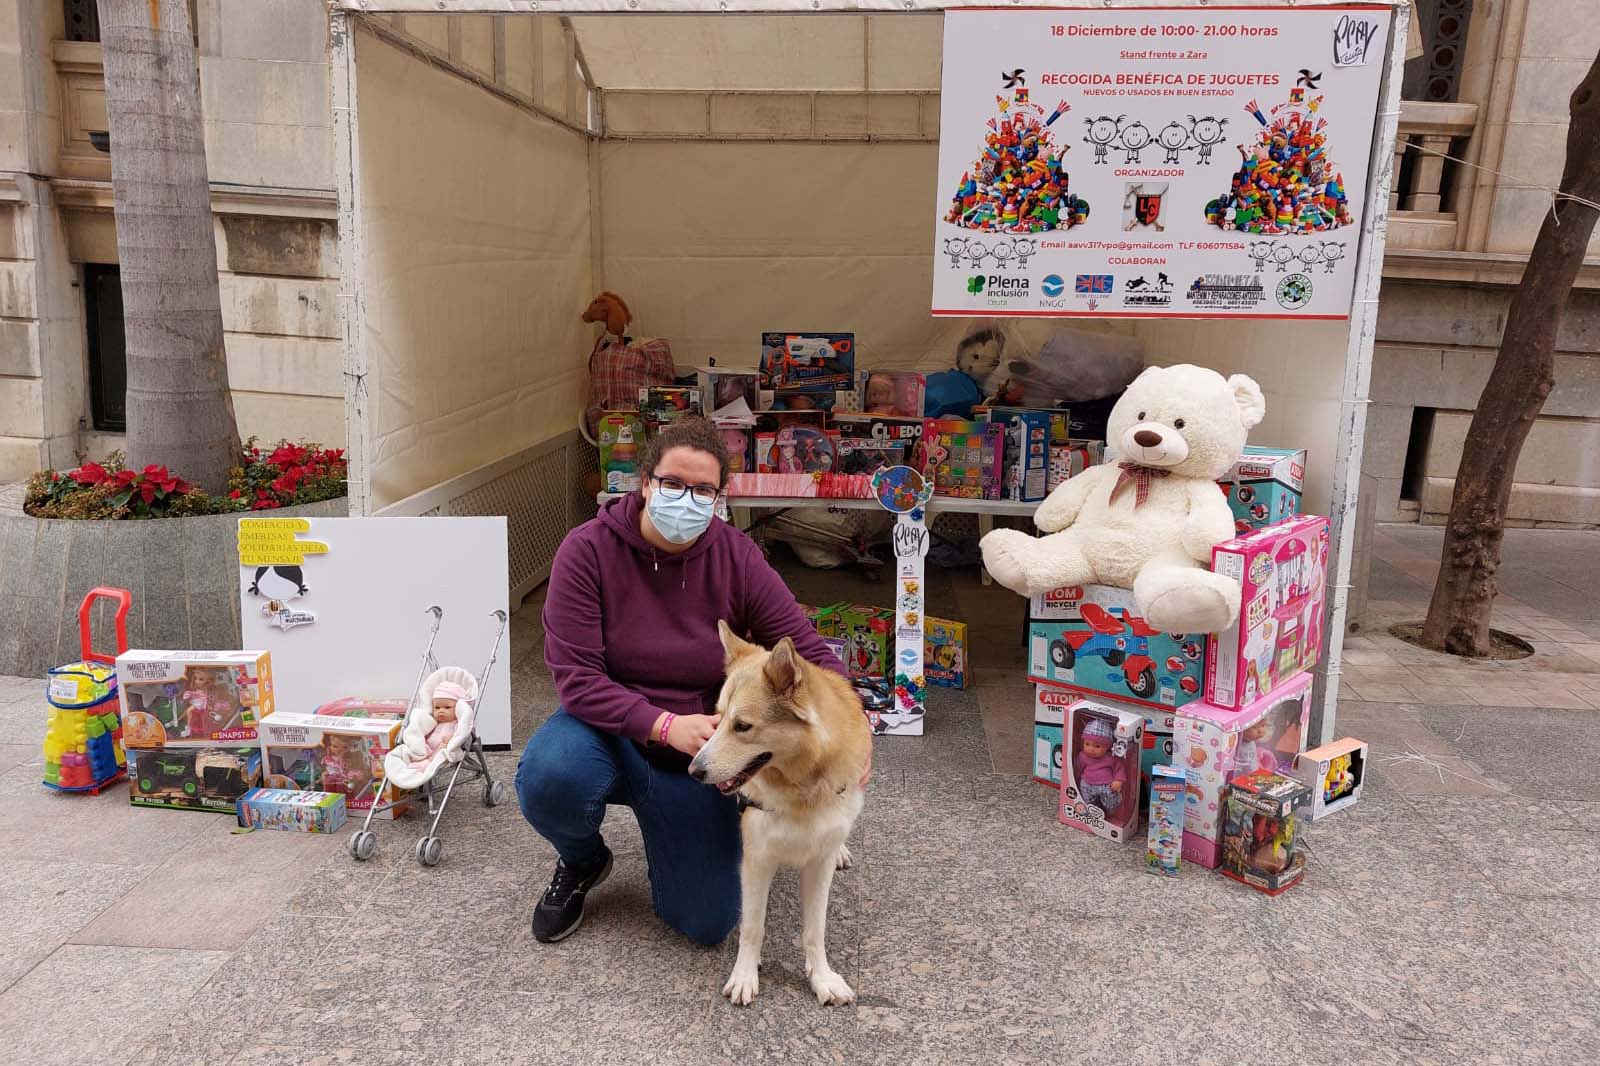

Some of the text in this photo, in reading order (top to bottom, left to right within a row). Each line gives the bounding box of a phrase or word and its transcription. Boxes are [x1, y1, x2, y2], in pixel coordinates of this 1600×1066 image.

[1050, 24, 1279, 36] 18 Diciembre de 10:00- 21.00 horas
[1120, 50, 1147, 59] Stand
[1148, 50, 1177, 59] frente
[1187, 50, 1208, 59] Zara
[1041, 72, 1280, 85] RECOGIDA BENÉFICA DE JUGUETES
[1114, 169, 1185, 177] ORGANIZADOR
[1041, 241, 1066, 249] Email
[1179, 242, 1195, 250] TLF
[1108, 257, 1166, 265] COLABORAN
[988, 275, 1029, 289] Plena
[987, 289, 1029, 297] inclusión
[872, 422, 923, 440] CLUEDO
[1046, 601, 1077, 609] RICYCLE
[1044, 693, 1079, 704] ATOM
